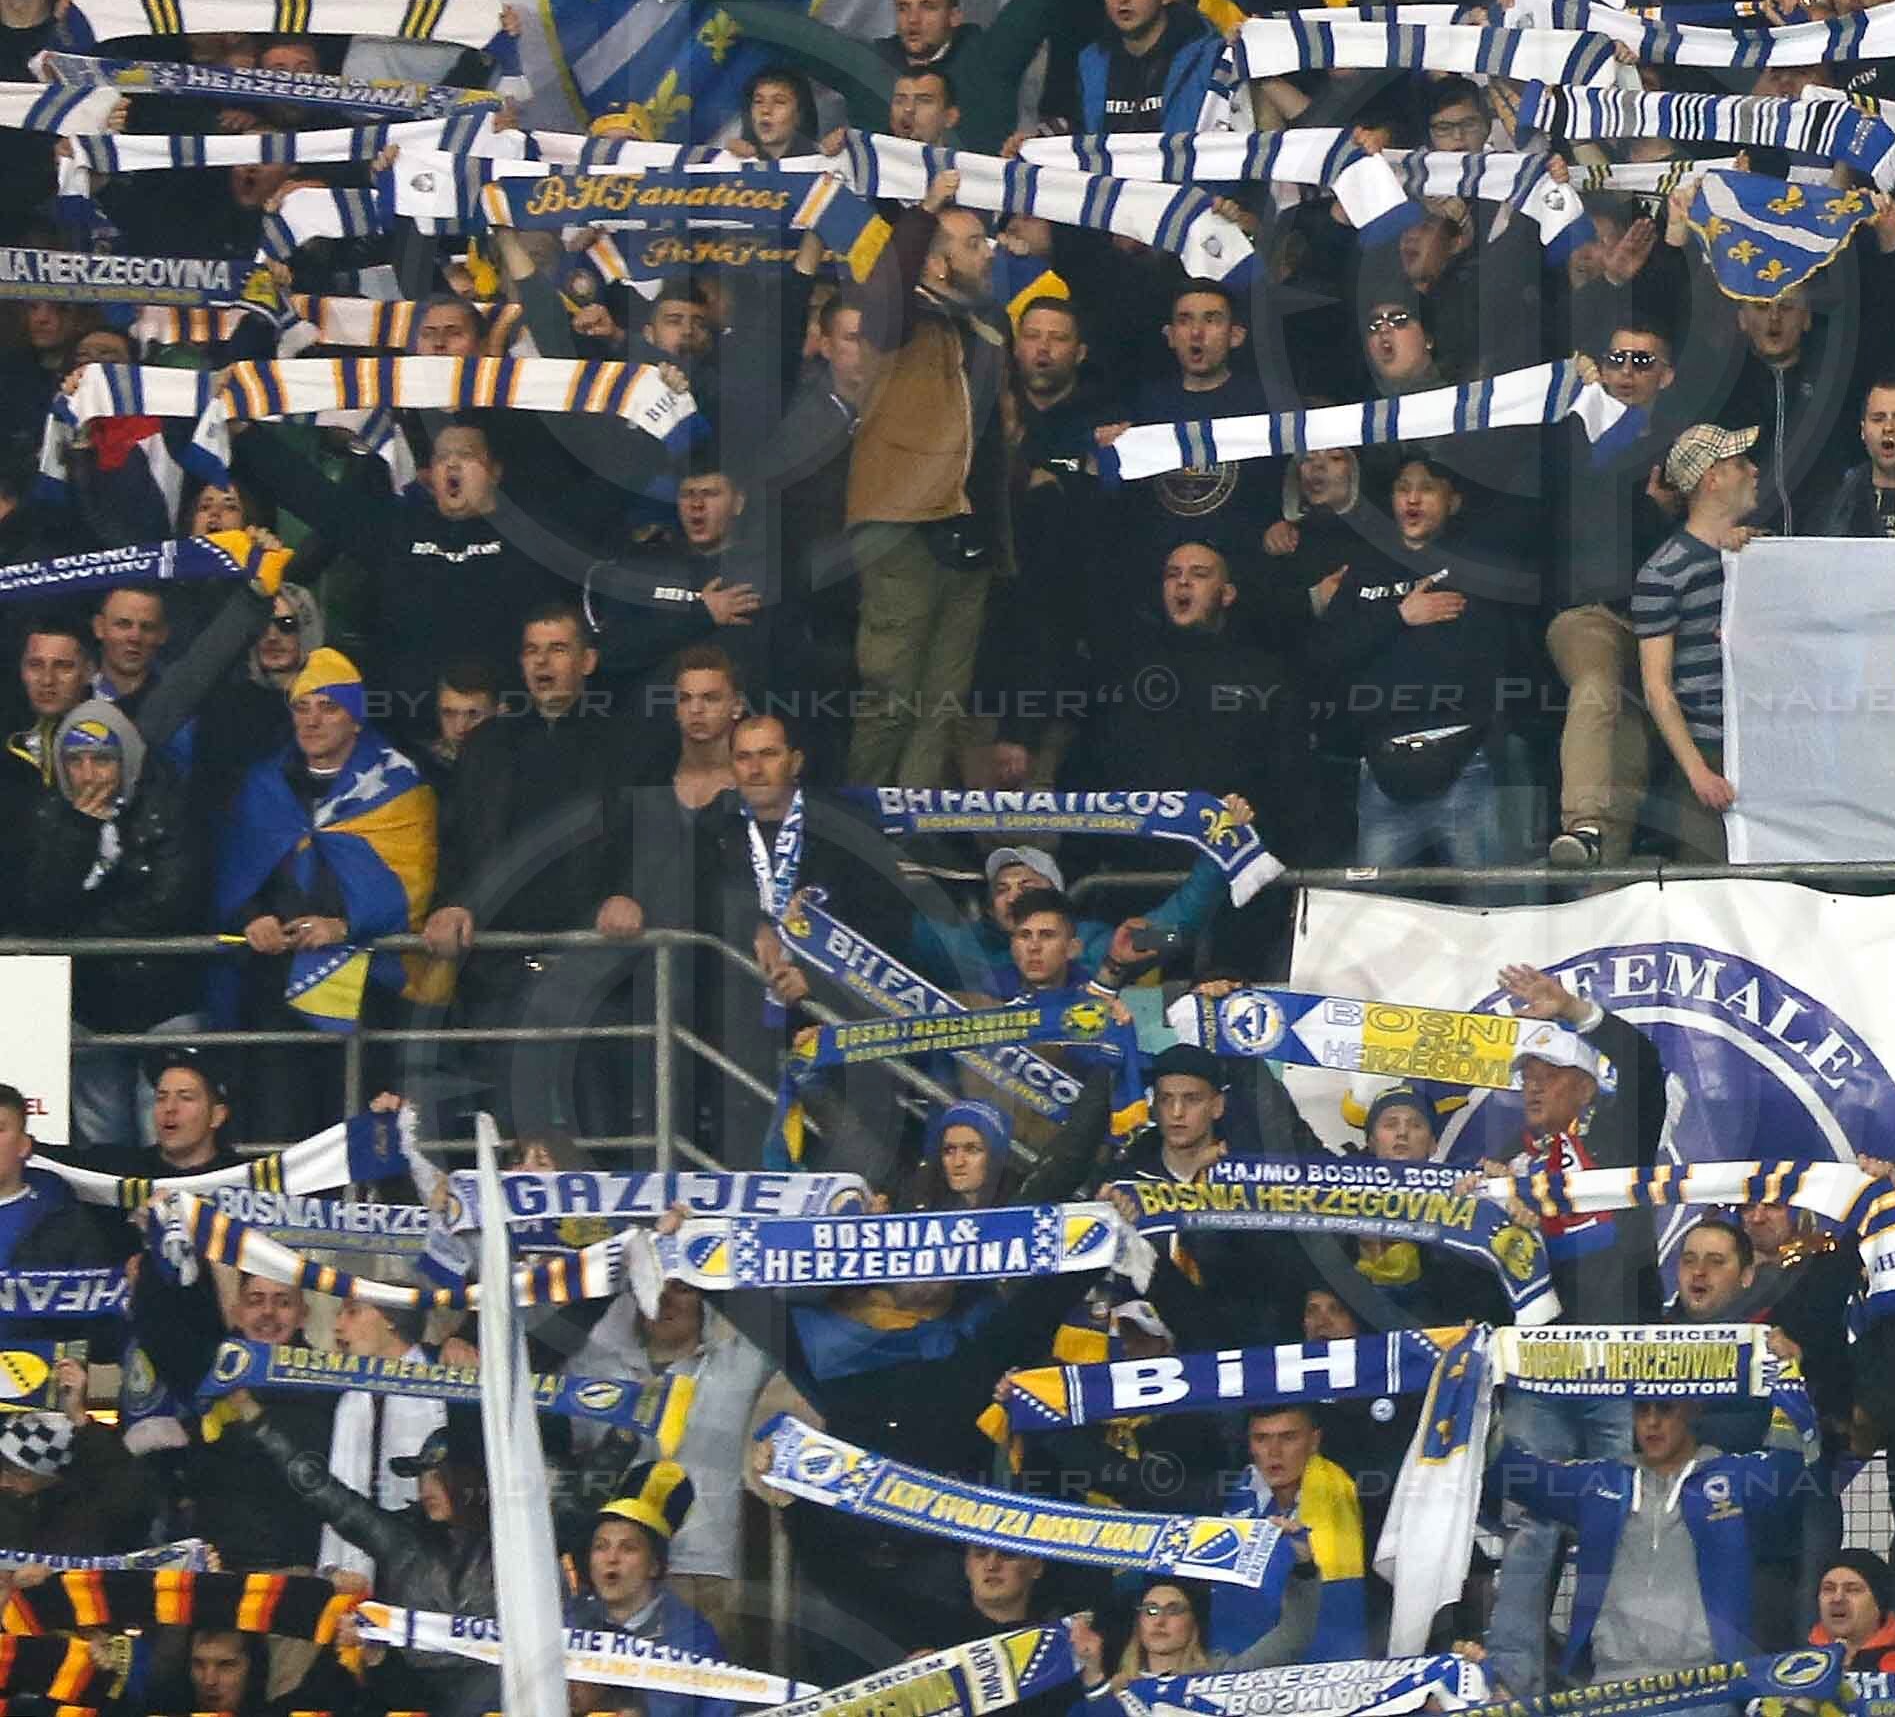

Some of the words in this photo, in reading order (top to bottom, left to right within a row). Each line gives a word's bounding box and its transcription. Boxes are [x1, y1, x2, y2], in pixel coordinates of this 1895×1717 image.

[526, 172, 790, 216] BHFanaticos
[38, 249, 232, 291] HERZEGOVINA
[1322, 1038, 1514, 1088] HERZEGOVI
[220, 1187, 326, 1228] BOSNIA
[331, 1200, 430, 1236] HERZE
[501, 1171, 790, 1217] GAZIJE
[1141, 1182, 1248, 1213] BOSNIA
[1256, 1184, 1477, 1232] HERZEGOVINA
[812, 1221, 946, 1249] BOSNIA
[949, 1218, 980, 1243] &
[762, 1236, 1028, 1282] HERZEGOVINA
[1520, 1329, 1610, 1343] VOLIMO
[1621, 1330, 1647, 1343] TE
[1654, 1329, 1738, 1343] SRCEM
[1109, 1338, 1358, 1410] BiH
[1517, 1381, 1626, 1400] BRANIMO
